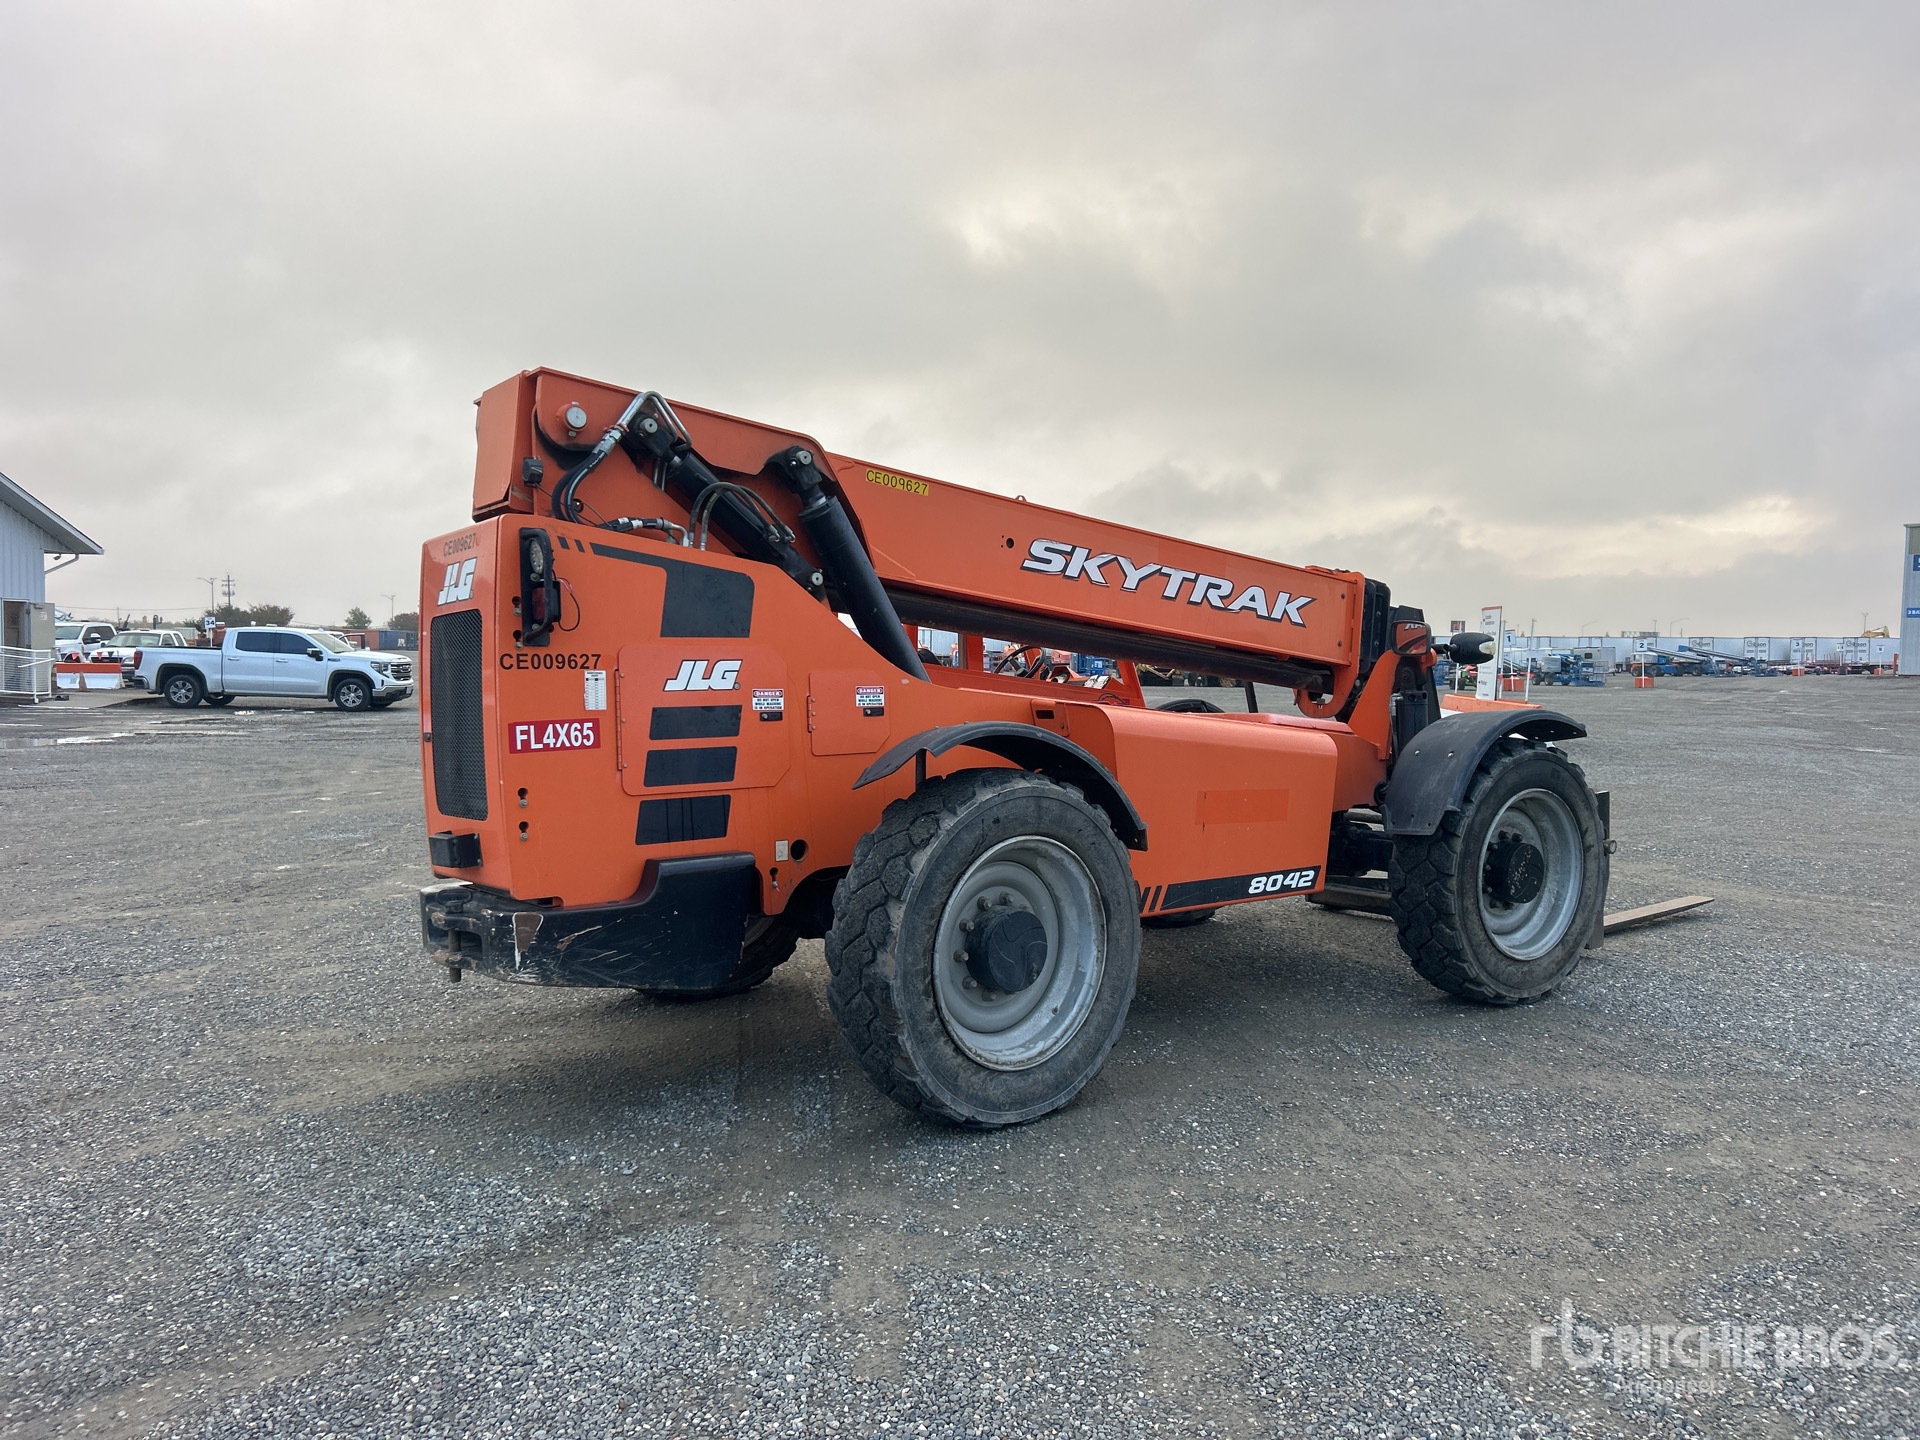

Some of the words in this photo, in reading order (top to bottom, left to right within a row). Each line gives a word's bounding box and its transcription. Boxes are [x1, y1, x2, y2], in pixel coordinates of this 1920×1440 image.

[867, 470, 928, 494] CE009627
[443, 533, 477, 557] CE009627
[437, 557, 478, 607] JLG
[1020, 537, 1317, 628] SKYTRAK
[500, 653, 602, 670] CE009627
[662, 659, 742, 692] JLG
[515, 721, 595, 750] FL4X65
[1248, 869, 1316, 895] 8042
